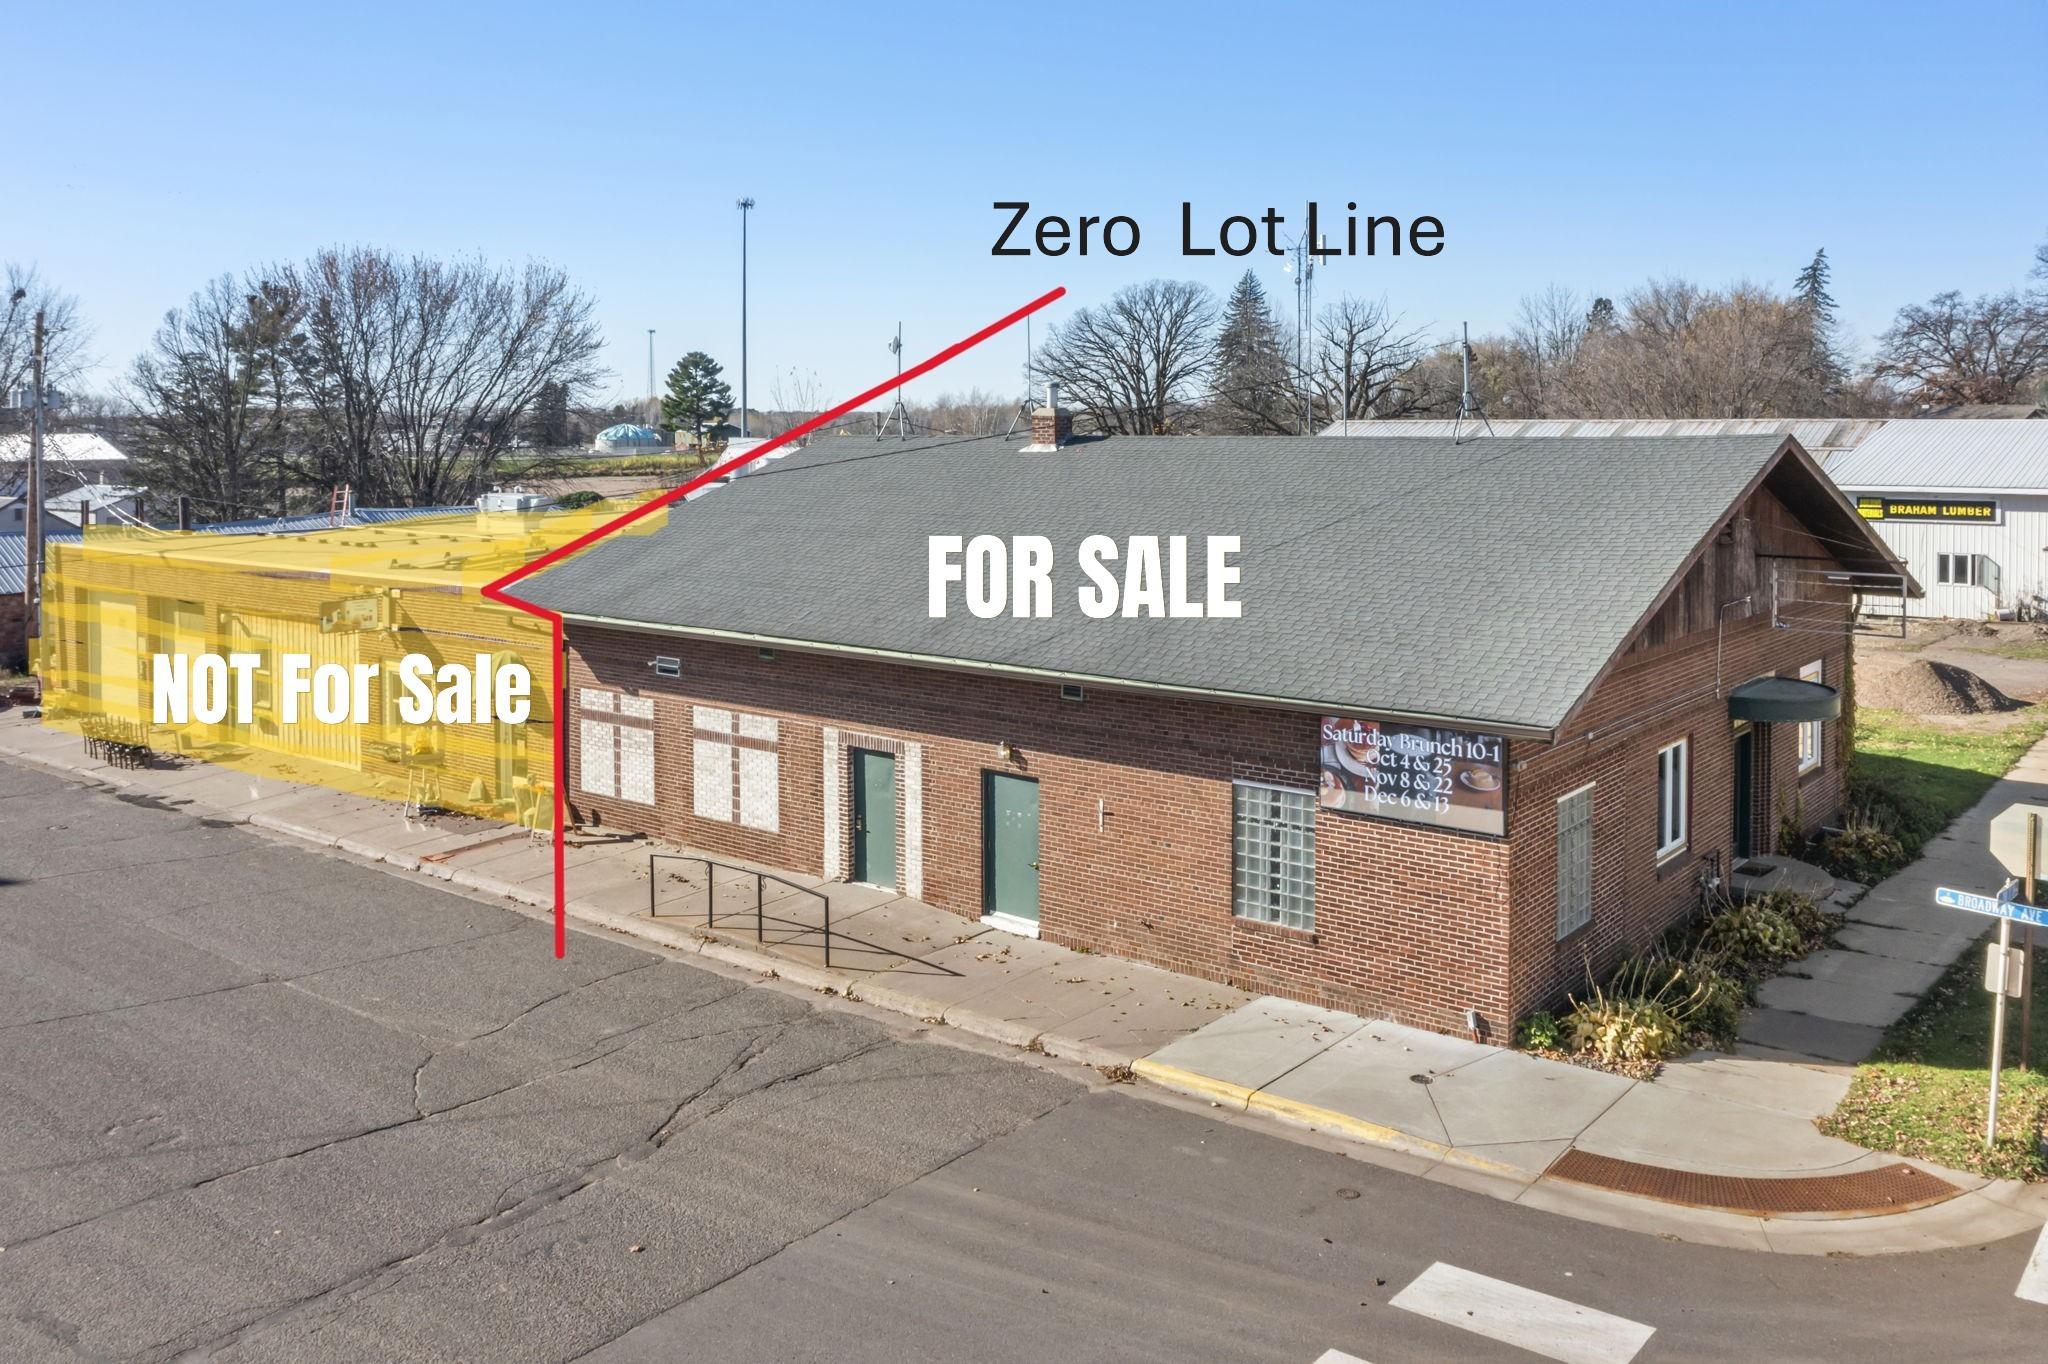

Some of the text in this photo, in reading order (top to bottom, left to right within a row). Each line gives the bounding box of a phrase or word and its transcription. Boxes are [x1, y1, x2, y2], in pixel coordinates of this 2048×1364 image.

[1889, 504, 1937, 515] BRAHAM
[1942, 505, 1992, 517] LUMBER
[1323, 724, 1392, 751] Saturday
[1400, 733, 1462, 757] Brunch
[1366, 750, 1452, 776] Oct 4 & 25
[1365, 766, 1453, 794] Nov 8 & 22
[1365, 785, 1449, 815] Dec 6 & 13
[1957, 894, 2043, 922] BROADWAY AVE
